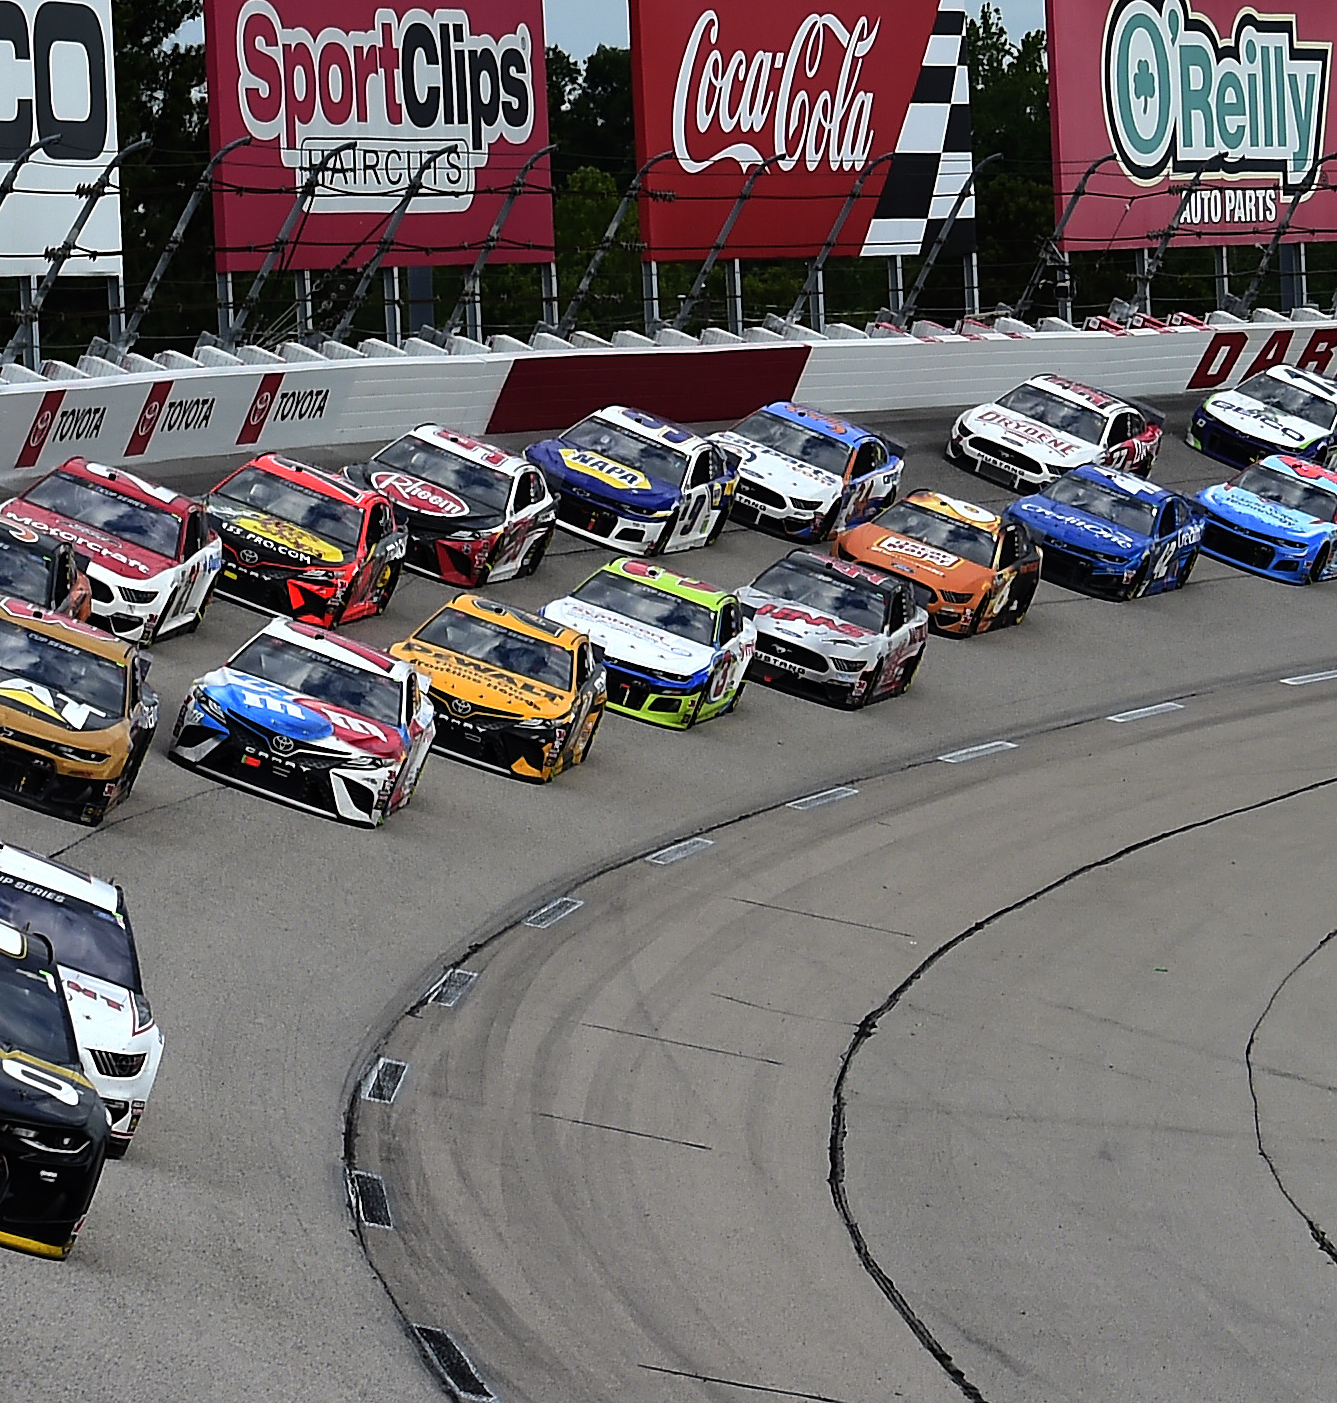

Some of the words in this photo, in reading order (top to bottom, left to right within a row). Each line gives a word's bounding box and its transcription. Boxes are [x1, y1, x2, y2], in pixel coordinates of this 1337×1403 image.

[1117, 8, 1316, 173] O'Reilly
[305, 148, 463, 187] HAIRCUTS
[1180, 190, 1221, 223] AUTO
[1225, 189, 1277, 222] PARTS
[161, 398, 215, 433] TOYOTA
[274, 389, 330, 422] TOYOTA
[52, 407, 107, 441] TOYOTA
[978, 410, 1081, 456] DRYDENE
[572, 452, 639, 485] NAPA
[977, 453, 1025, 477] MUSTANG
[378, 475, 462, 515] Rheem
[739, 496, 767, 512] TANG
[5, 511, 150, 574] Motorcraft
[245, 533, 311, 565] PRO.COM
[402, 642, 565, 706] DEWALT
[755, 652, 806, 675] USTANG
[245, 746, 312, 773] CAMRY
[13, 879, 67, 903] SERIES
